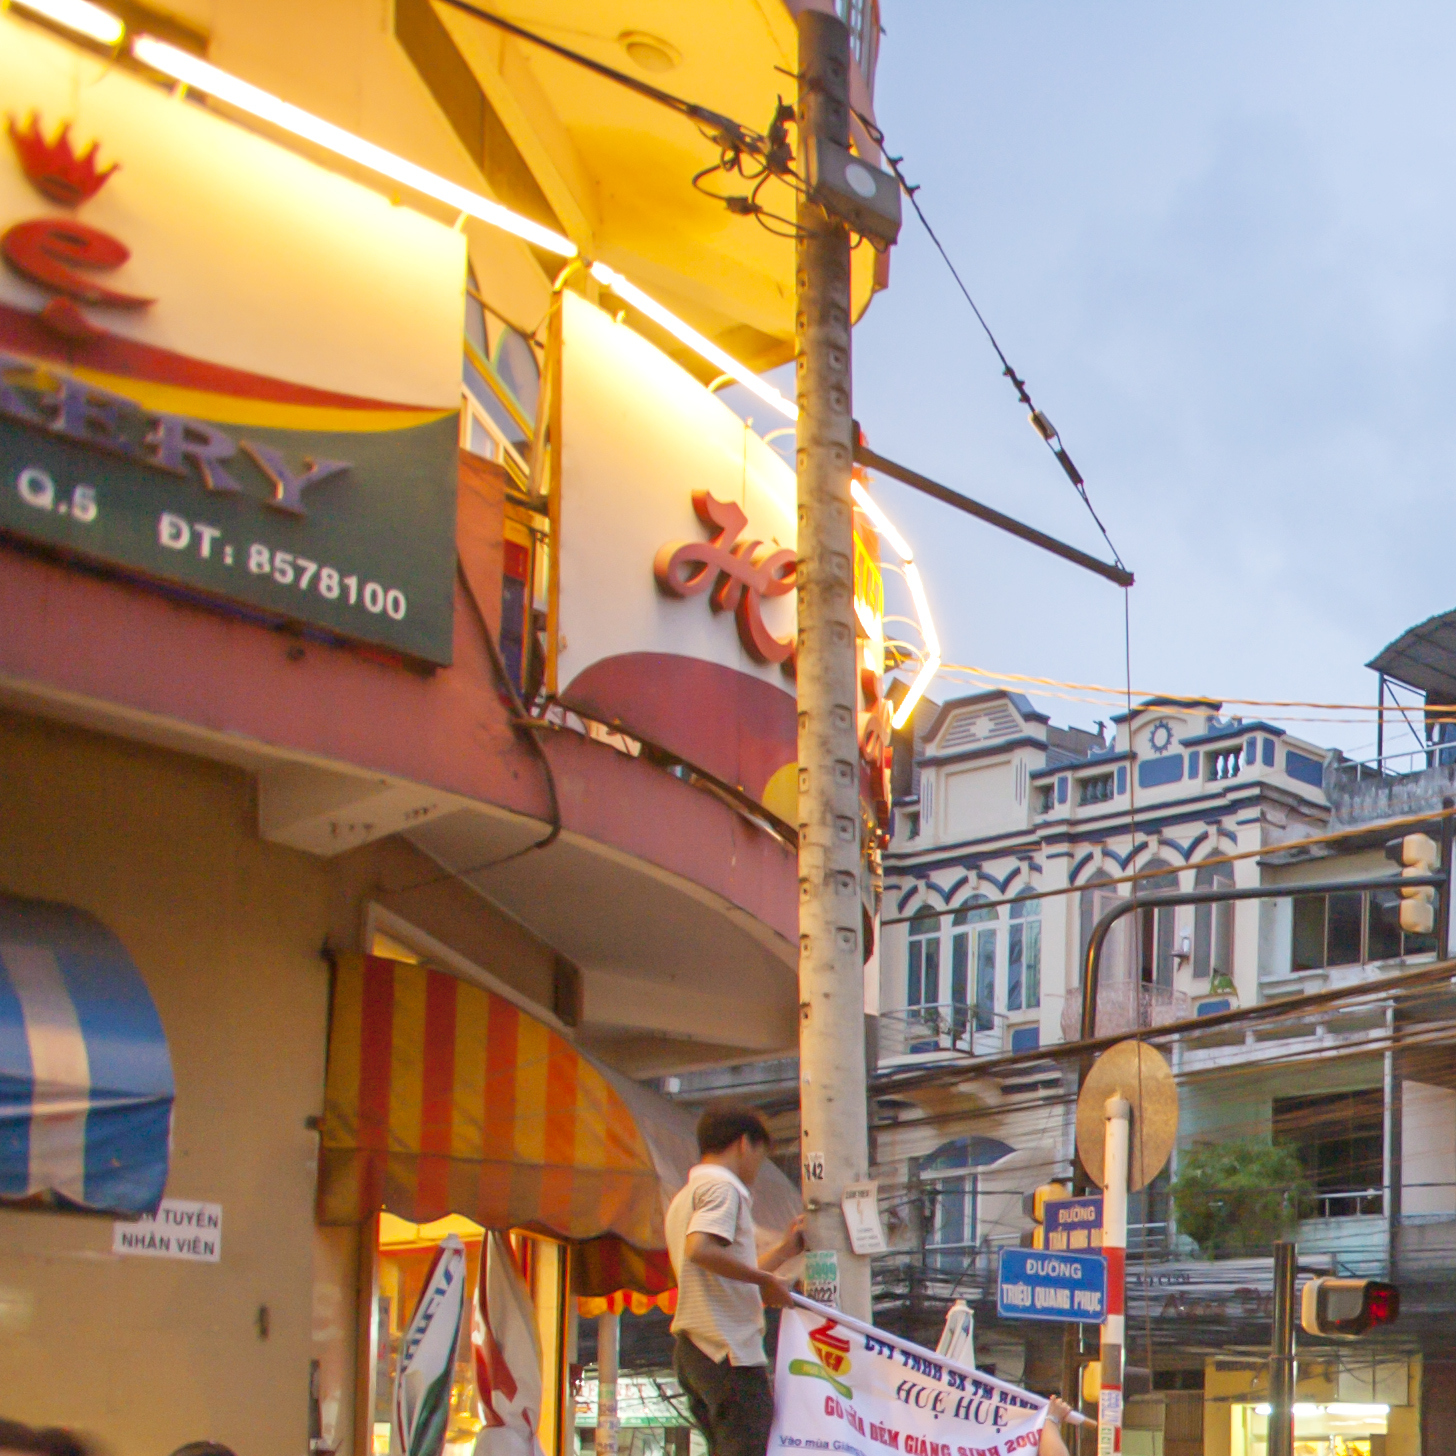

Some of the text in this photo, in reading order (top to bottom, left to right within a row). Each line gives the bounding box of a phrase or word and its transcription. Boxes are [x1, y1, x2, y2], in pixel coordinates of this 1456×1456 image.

[17, 467, 98, 522] Q.5
[248, 542, 407, 621] 8578100
[1026, 1256, 1083, 1280] ĐƯỜNG
[1035, 1285, 1071, 1310] QUANG
[895, 1379, 1009, 1434] HUỆ HUỆ
